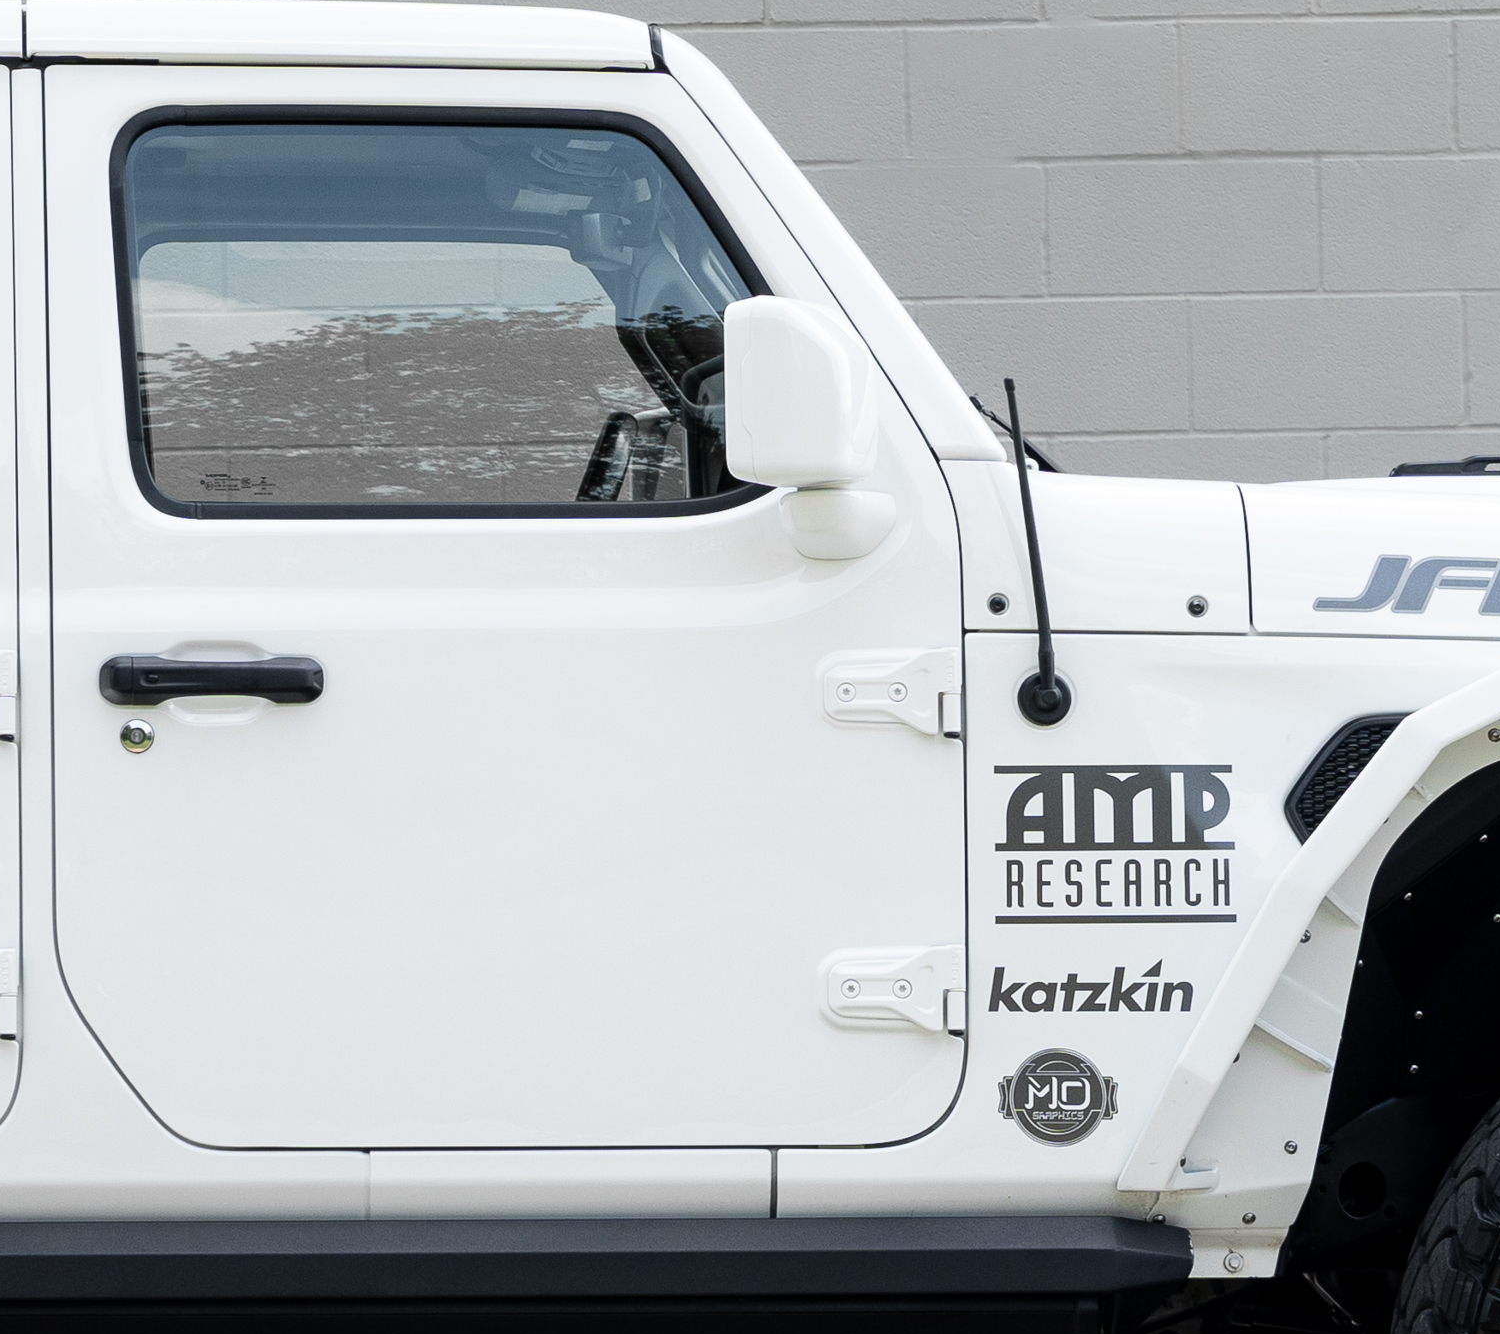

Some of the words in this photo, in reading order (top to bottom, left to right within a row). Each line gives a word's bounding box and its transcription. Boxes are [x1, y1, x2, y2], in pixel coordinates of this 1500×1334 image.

[995, 765, 1235, 851] AMP
[1007, 859, 1230, 907] RESEARCH
[989, 959, 1193, 1012] katzkin
[1025, 1077, 1091, 1110] MO
[1032, 1111, 1085, 1120] GRAPHICS
